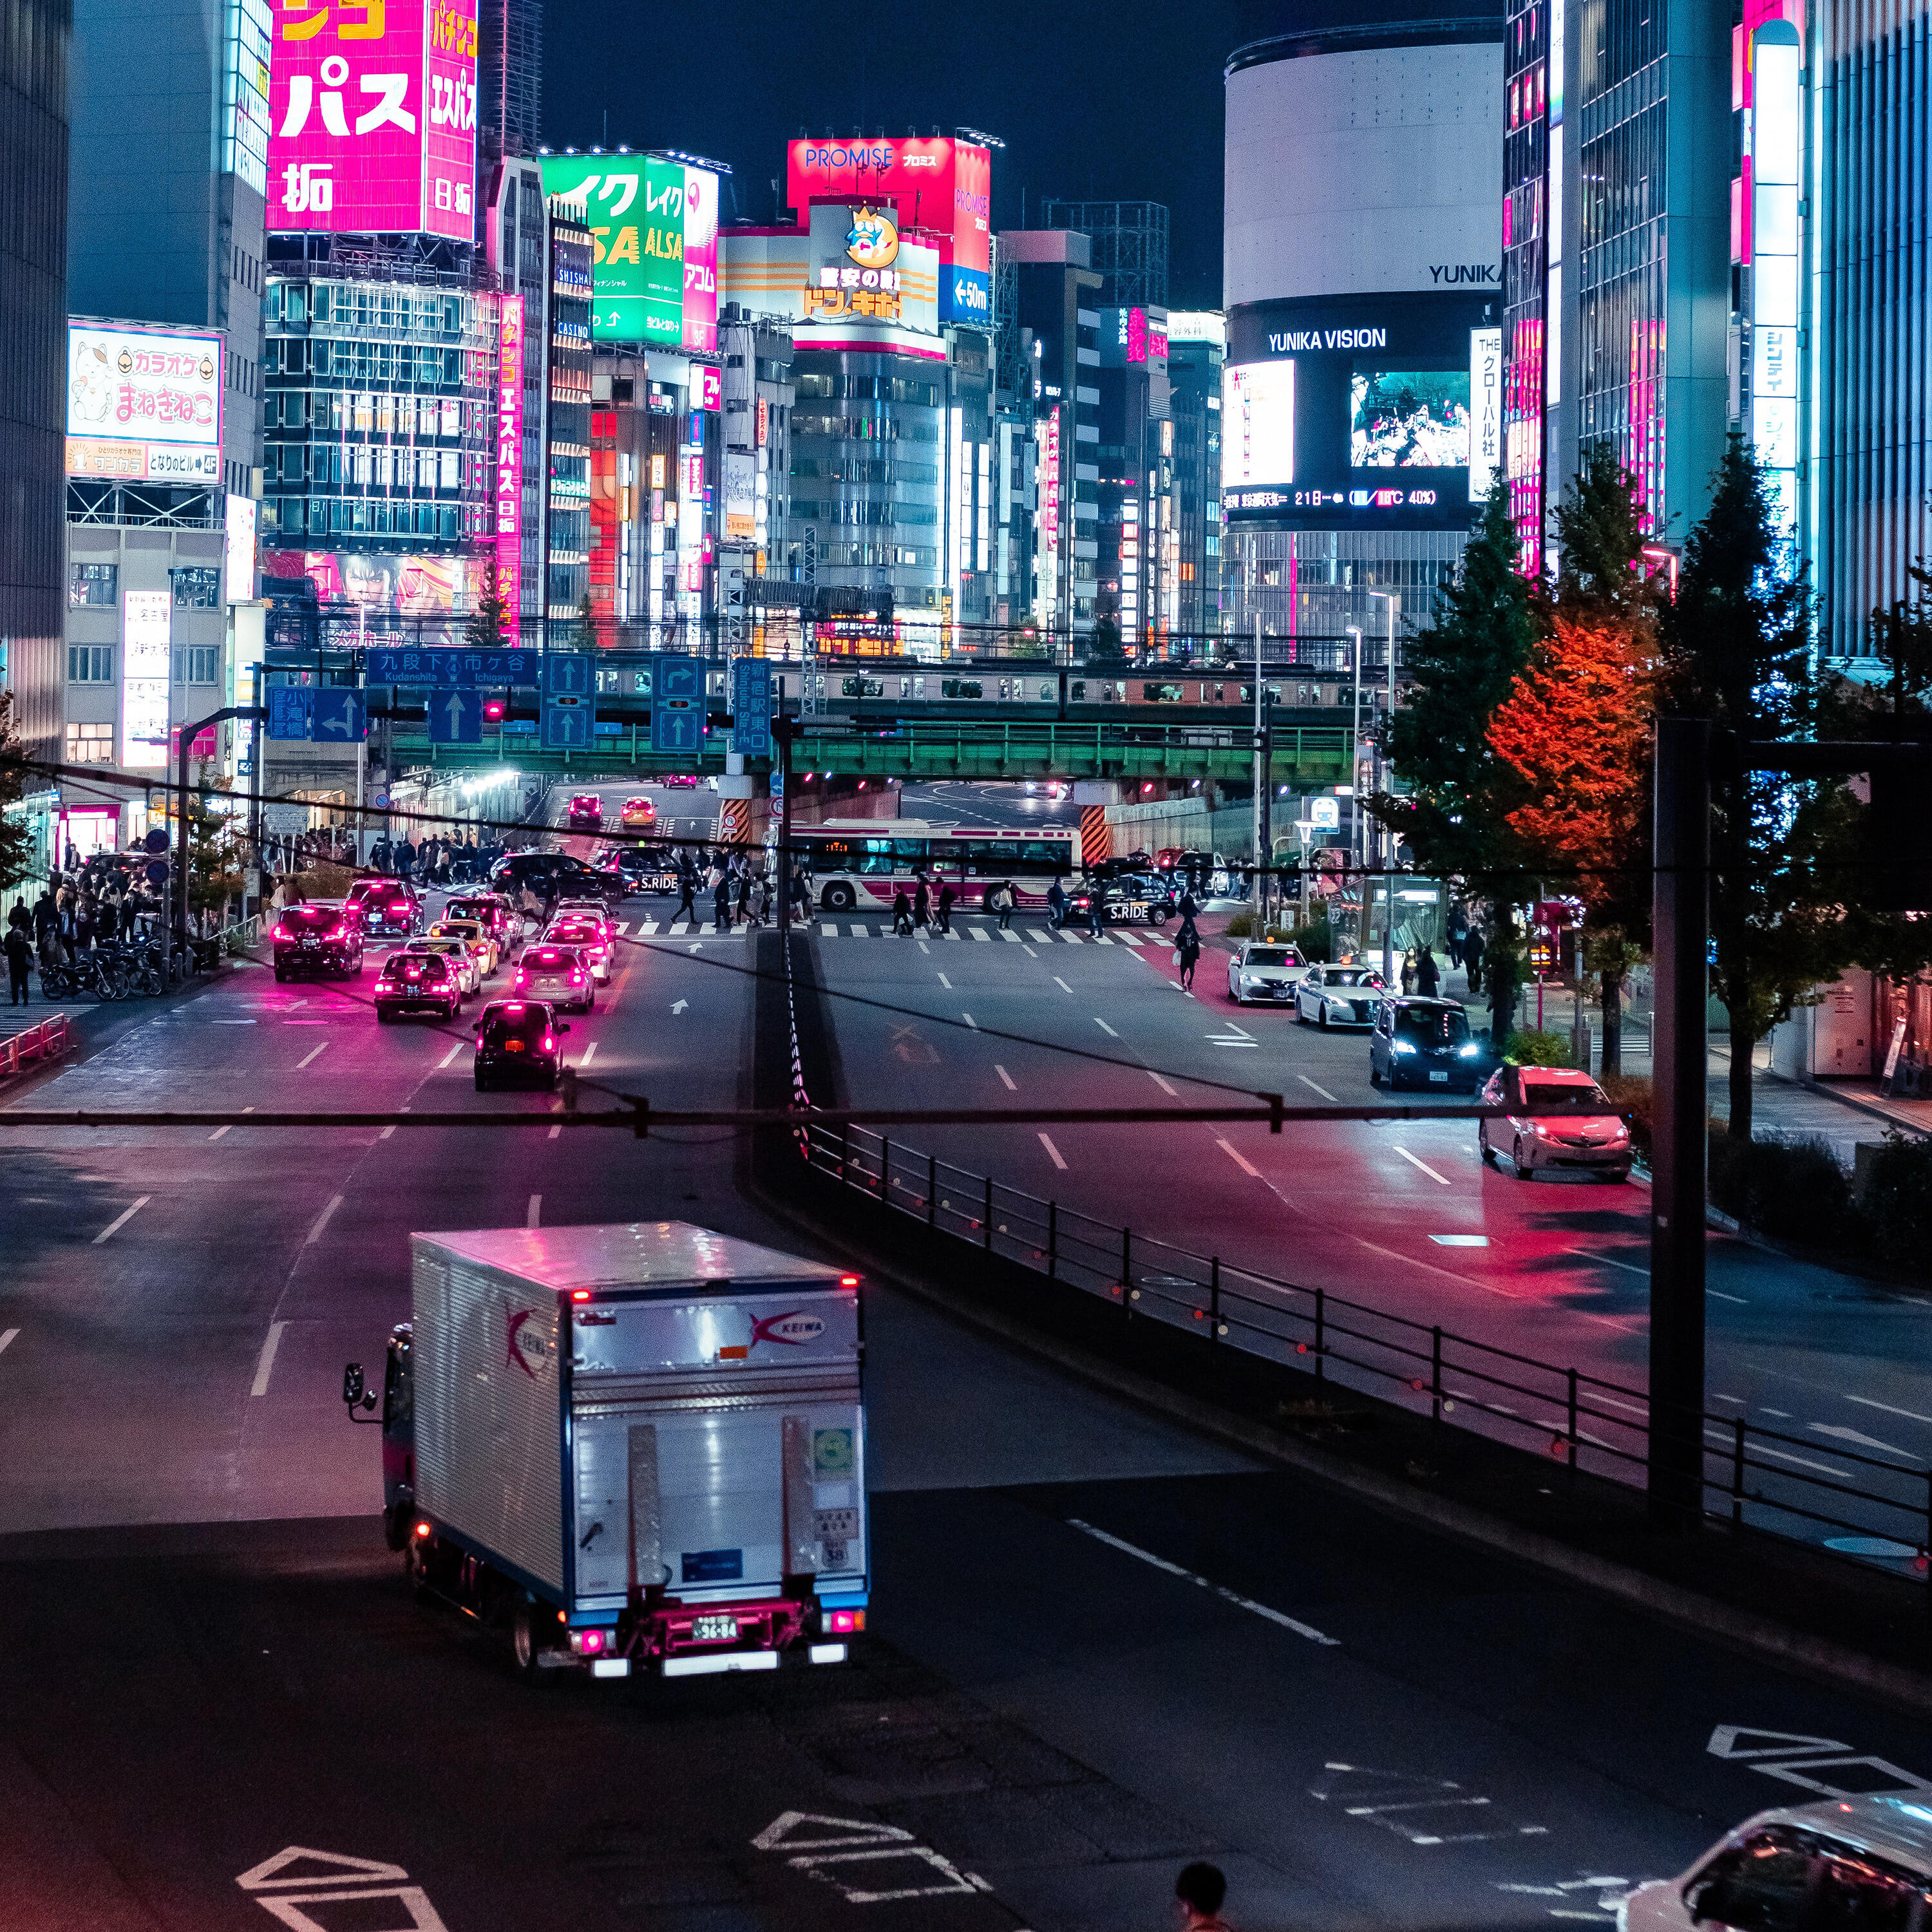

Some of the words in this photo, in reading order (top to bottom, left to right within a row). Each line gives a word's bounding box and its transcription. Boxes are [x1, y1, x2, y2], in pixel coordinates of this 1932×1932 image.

[432, 0, 478, 57] パチンコ
[430, 68, 477, 132] エスパス
[806, 148, 893, 168] PROMISE
[903, 154, 936, 167] プロミス
[281, 164, 333, 212] 拓
[435, 178, 471, 215] 日拓
[647, 180, 683, 218] レイク
[956, 189, 987, 217] PROMISE
[645, 227, 683, 261] ALSA
[559, 269, 589, 285] SHISHA
[684, 263, 715, 293] アコム
[1428, 264, 1502, 283] YUNIK
[967, 281, 987, 310] 50m
[558, 322, 589, 339] CASINO
[1269, 330, 1322, 352] YUNIKA
[1324, 328, 1386, 348] VISION
[501, 308, 517, 382] パチンコ
[1479, 339, 1501, 351] THE
[135, 352, 197, 376] カラオケ
[117, 381, 213, 424] まねきねこ
[1482, 355, 1495, 457] グローバル社
[498, 388, 515, 495] エスパス
[93, 455, 142, 473] ワンカラ
[150, 453, 194, 472] となりのビル
[205, 455, 217, 474] 4F
[498, 500, 515, 533] 日拓
[380, 654, 443, 670] 九段下
[386, 672, 437, 681] Kudanshita
[475, 672, 514, 683] Ichigaya
[739, 665, 750, 709] Shinjuku
[286, 692, 304, 736] 小滝橋
[751, 663, 766, 748] 新宿駅東口
[641, 878, 677, 889] S.RIDE
[1111, 906, 1148, 919] S.RIDE
[782, 1322, 822, 1333] KEIWA
